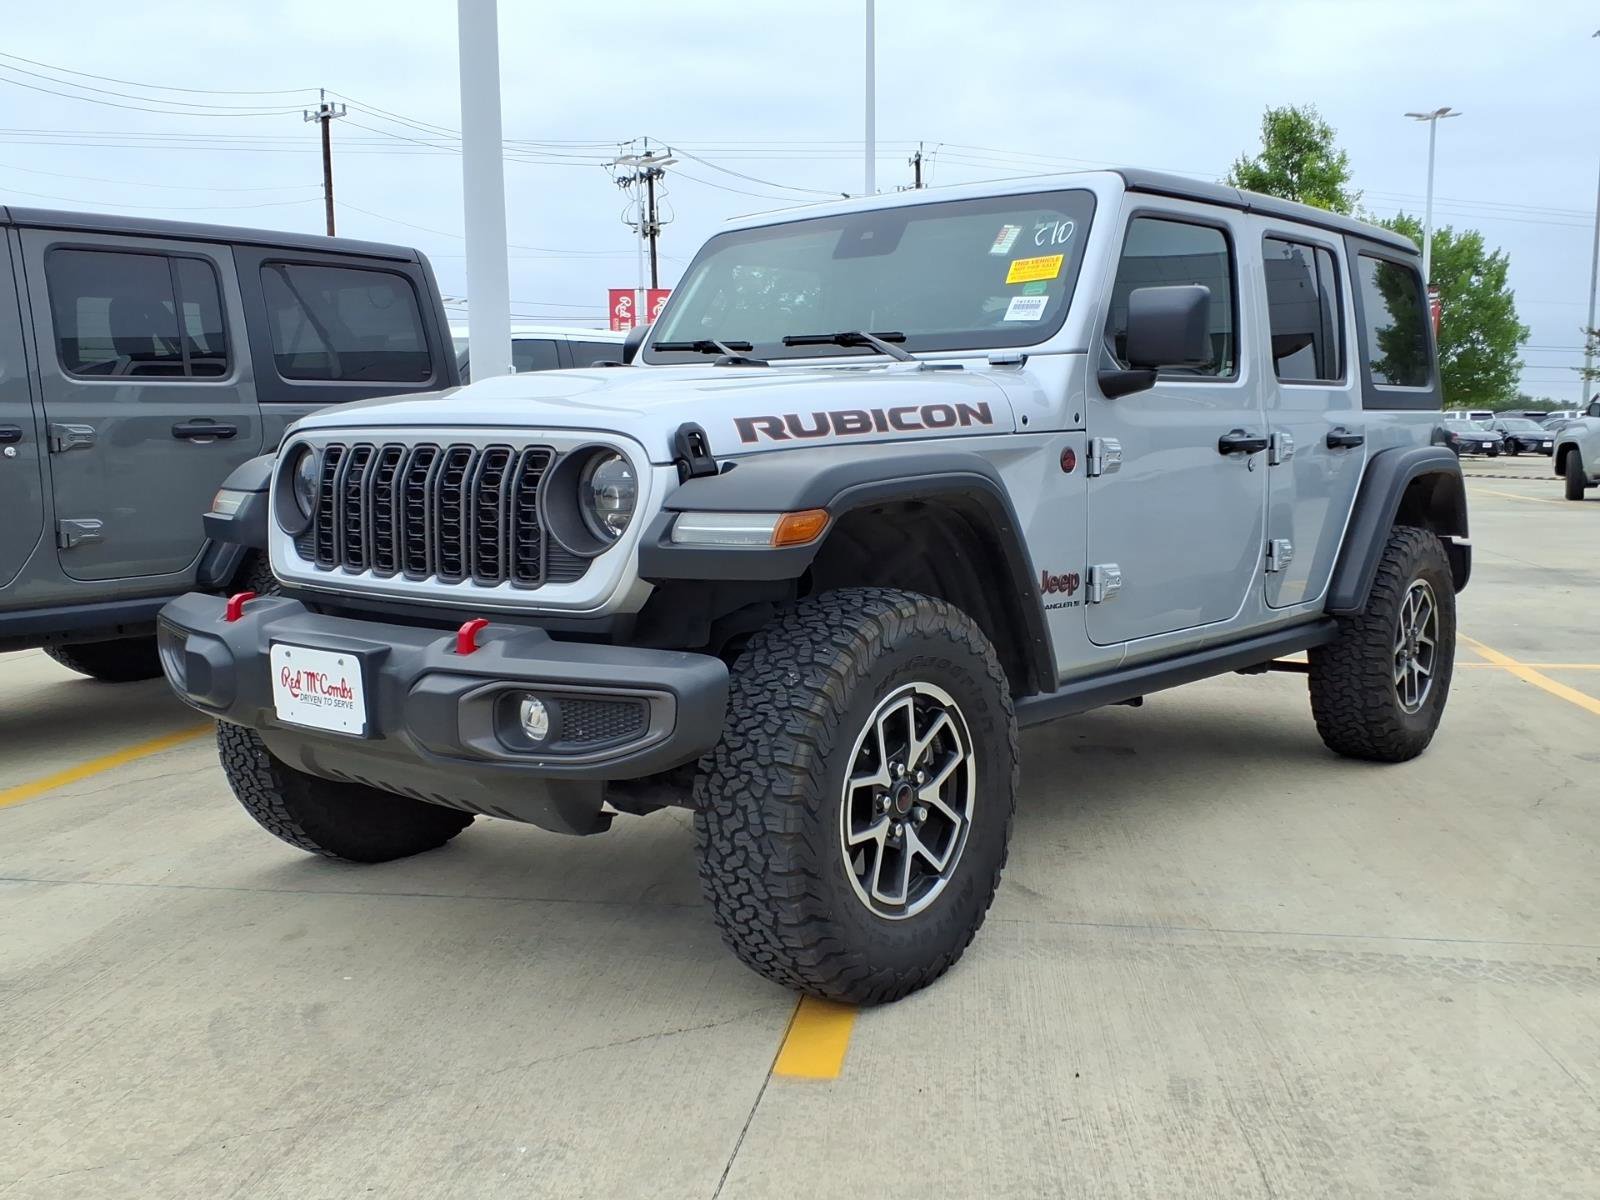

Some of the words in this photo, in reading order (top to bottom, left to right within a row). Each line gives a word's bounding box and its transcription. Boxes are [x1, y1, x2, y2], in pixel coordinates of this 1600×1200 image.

[733, 402, 994, 443] RUBICON
[1040, 570, 1080, 597] Jeep
[1044, 601, 1073, 610] ANGLER
[281, 666, 302, 698] Red
[303, 670, 353, 700] McCombs
[300, 693, 323, 704] DRIVEN
[324, 697, 333, 706] TO
[334, 699, 354, 710] SERVE
